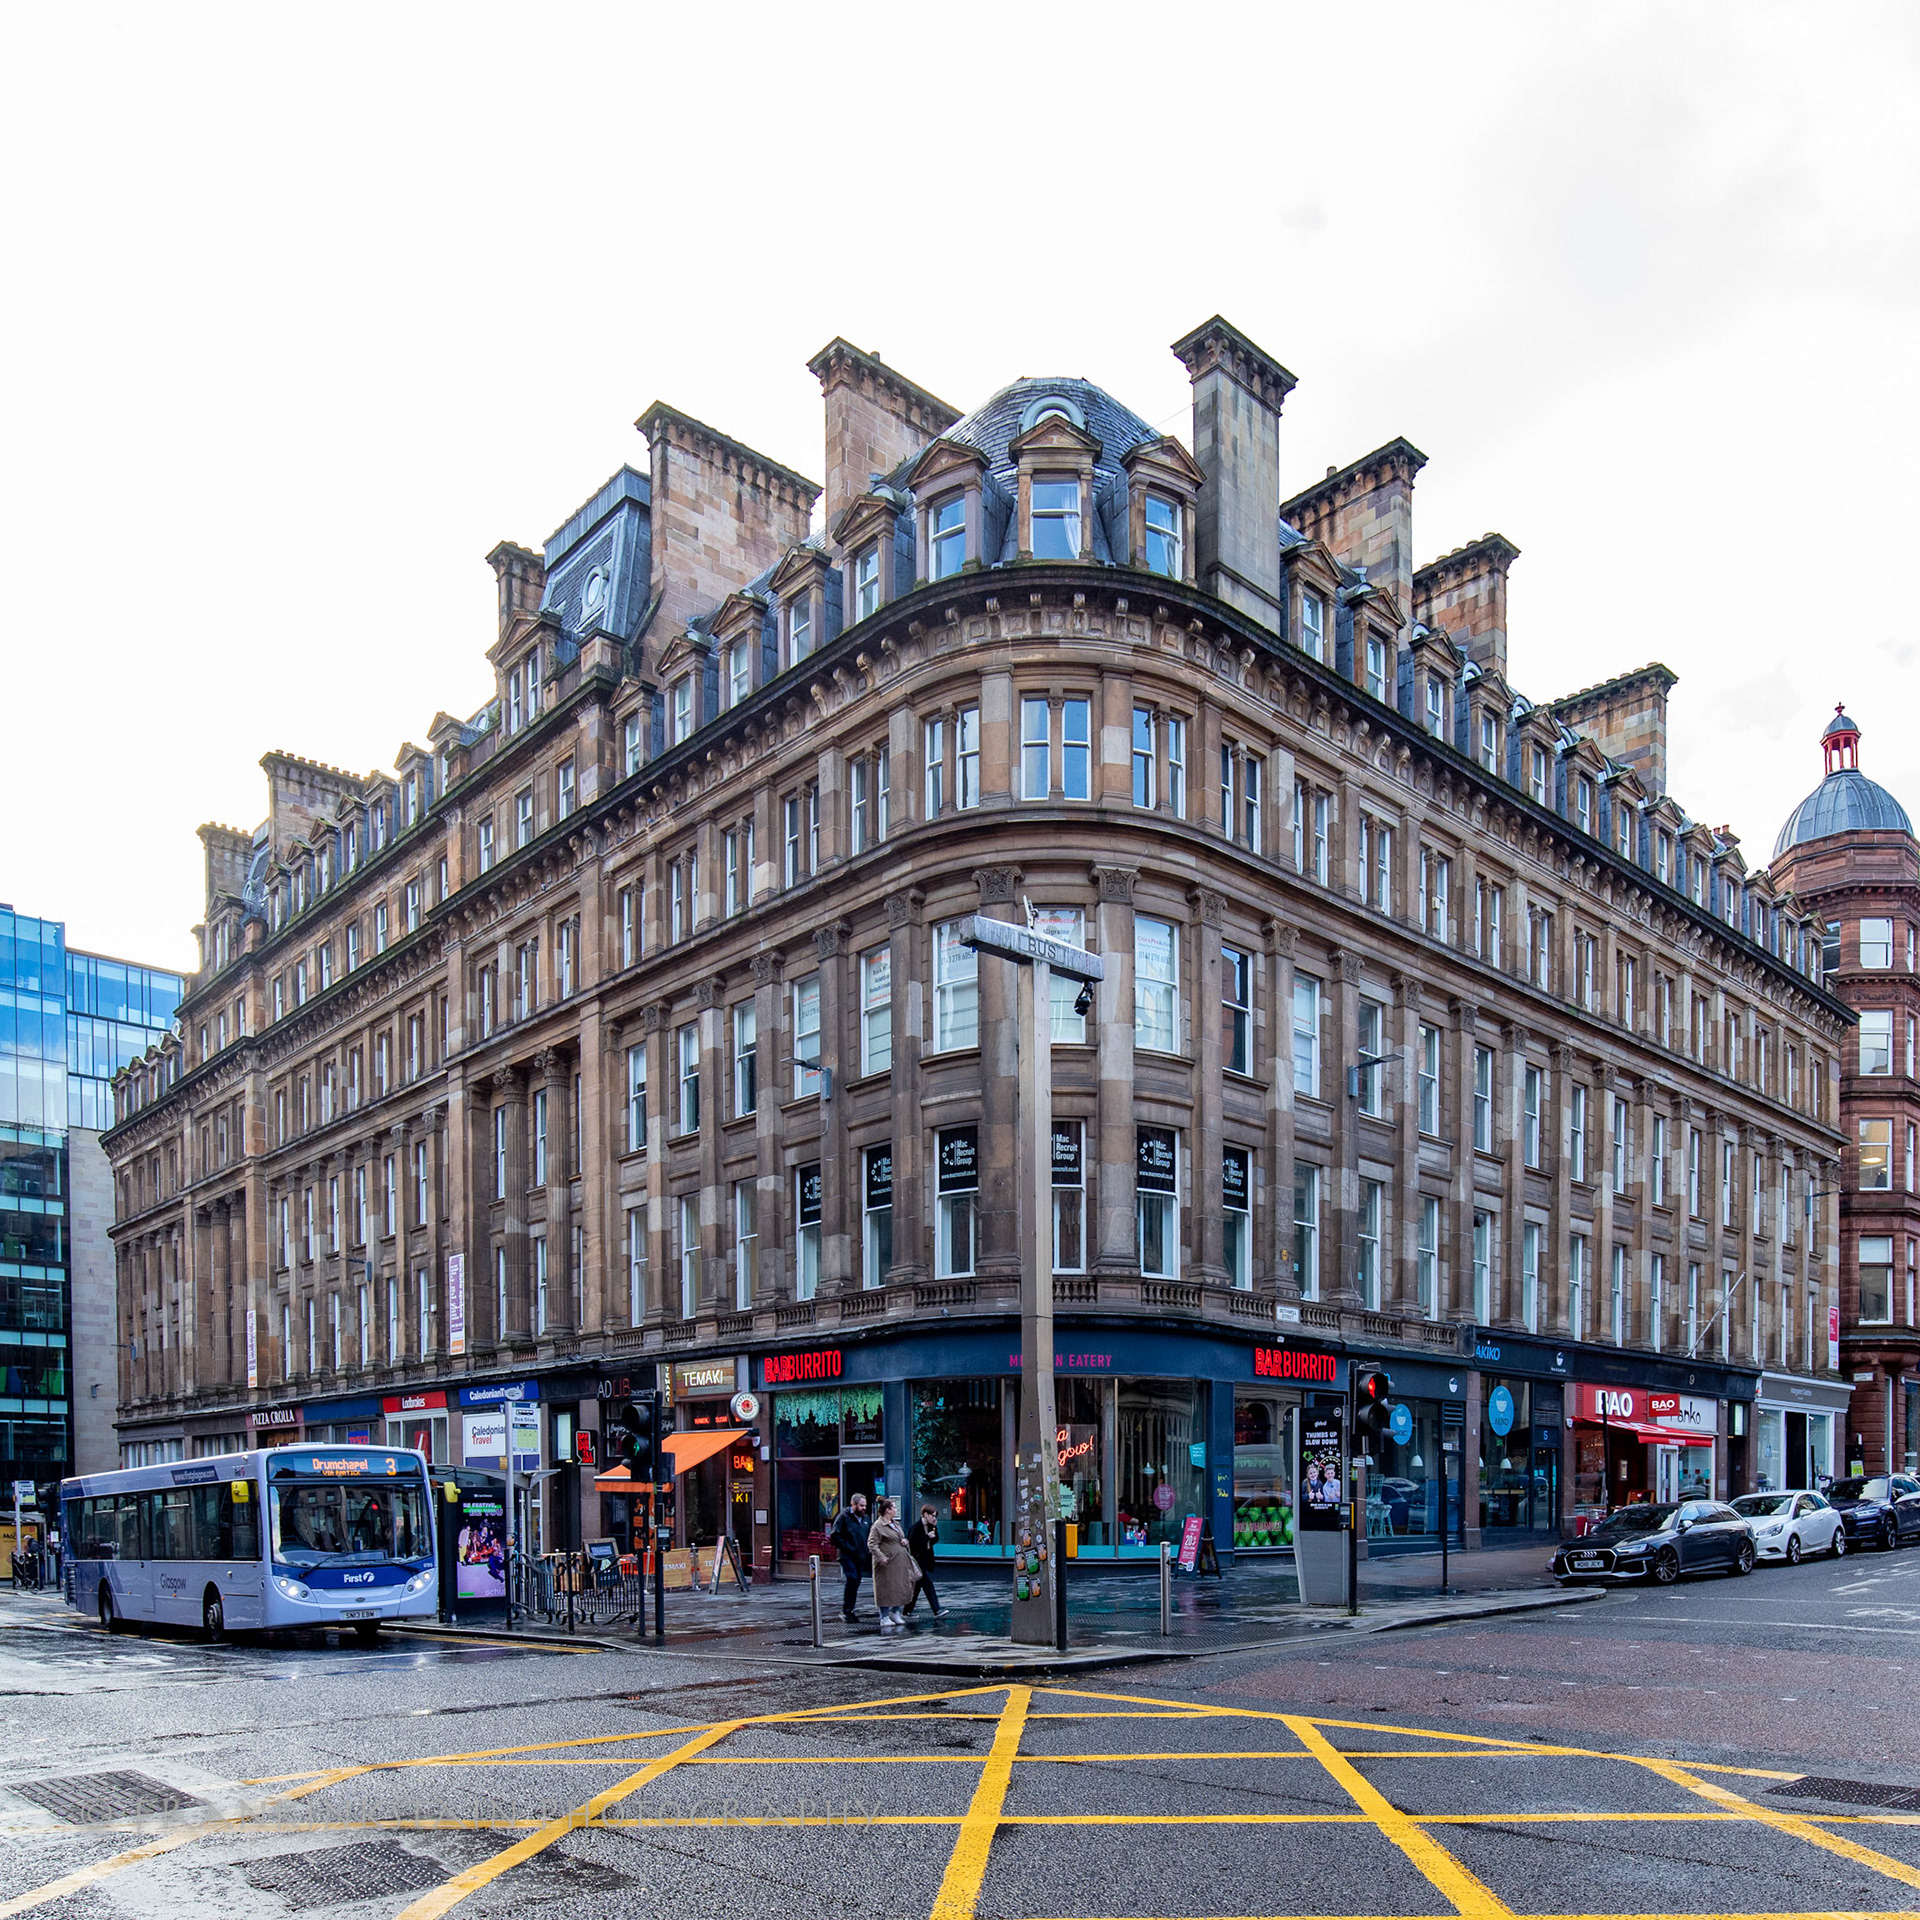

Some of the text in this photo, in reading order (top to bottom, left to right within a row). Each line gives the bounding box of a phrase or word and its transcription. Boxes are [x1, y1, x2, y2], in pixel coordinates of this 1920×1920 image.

[1028, 937, 1056, 959] BUS
[952, 953, 961, 963] 278
[962, 951, 975, 961] 6052
[1056, 1133, 1069, 1144] Mac
[956, 1140, 968, 1149] Mac
[1056, 1143, 1079, 1152] Recruit
[1155, 1141, 1167, 1151] Mac
[956, 1148, 976, 1157] Recruit
[1056, 1151, 1075, 1161] Group
[1156, 1149, 1173, 1160] Recruit
[881, 1157, 891, 1166] Mac
[956, 1156, 973, 1166] Group
[1156, 1158, 1171, 1169] Group
[1230, 1159, 1239, 1169] Mac
[1230, 1166, 1244, 1178] Recruit
[1230, 1175, 1242, 1187] Group
[1475, 1345, 1500, 1361] AKIKO
[764, 1350, 841, 1383] BARBURRITO
[1068, 1354, 1112, 1368] EATERY
[1255, 1348, 1336, 1381] BARBURRITO
[683, 1369, 723, 1387] TEMAKI
[1689, 1374, 1695, 1386] 9
[402, 1396, 426, 1409] Ladbrokes
[1595, 1390, 1633, 1417] BAO
[1651, 1400, 1675, 1409] BAO
[252, 1409, 295, 1426] PIZZA CROLLA
[472, 1434, 492, 1445] Travel
[1543, 1430, 1549, 1440] 5
[312, 1457, 397, 1476] Drumchapel 3
[160, 1573, 187, 1593] Glasgow
[344, 1574, 363, 1583] First
